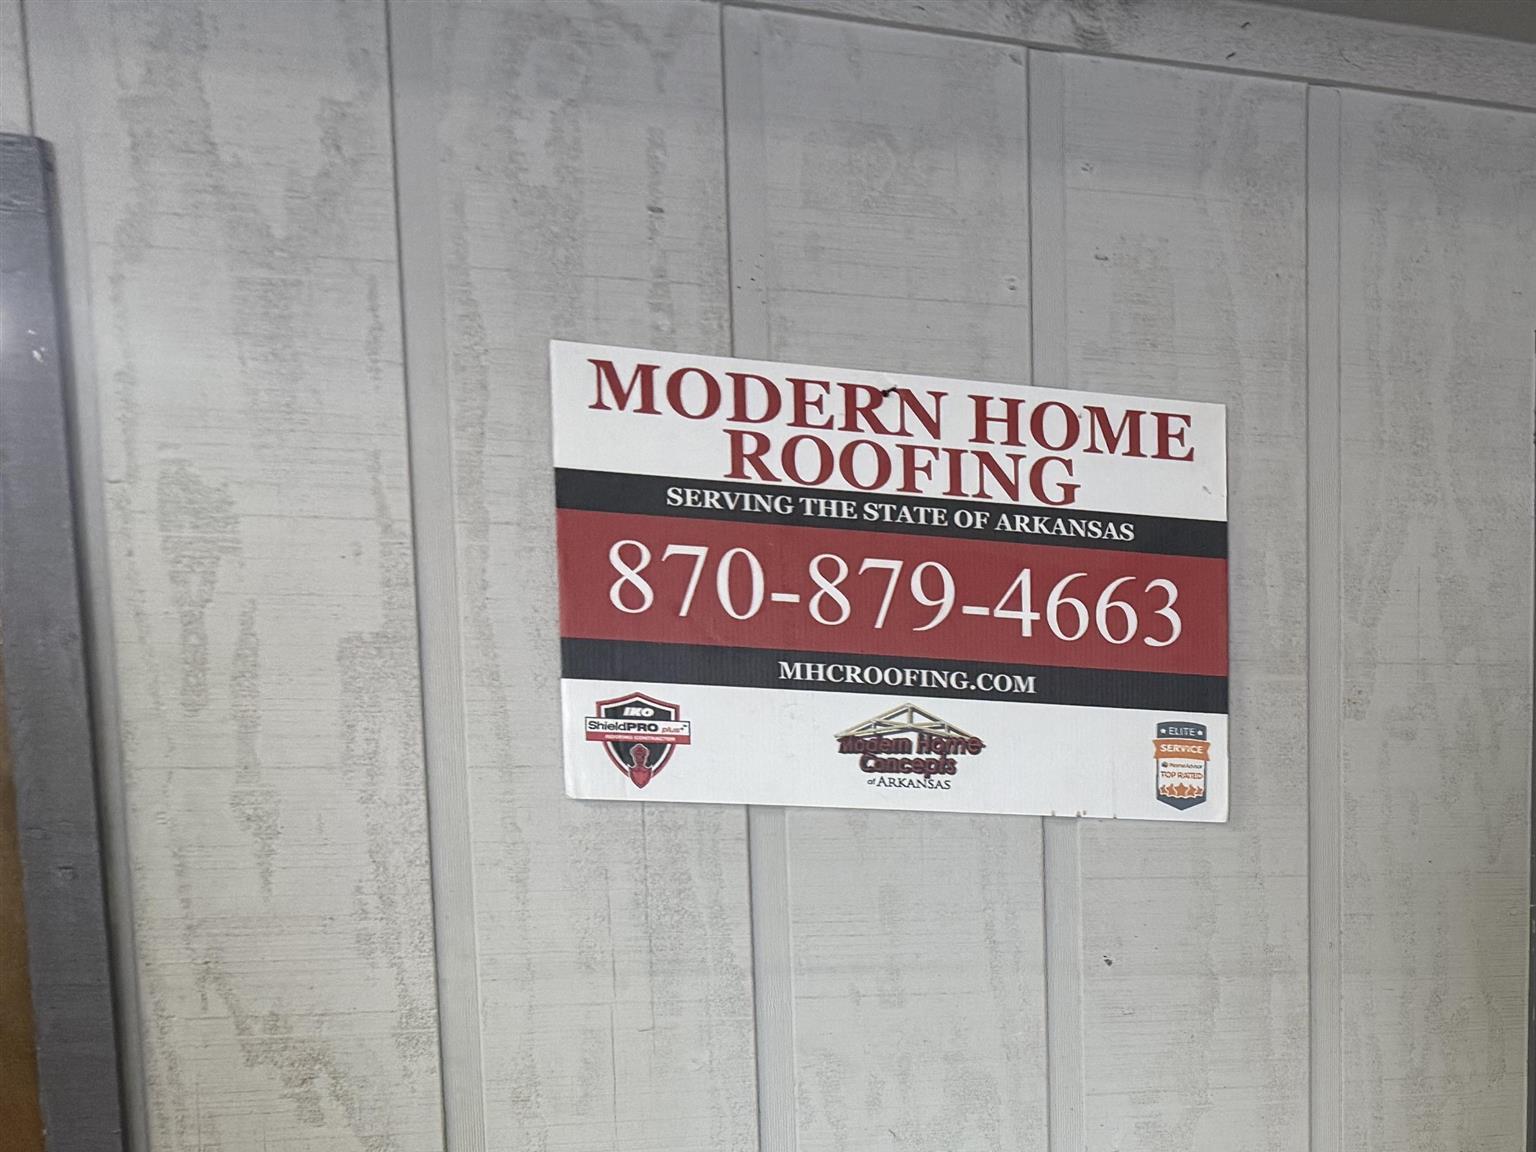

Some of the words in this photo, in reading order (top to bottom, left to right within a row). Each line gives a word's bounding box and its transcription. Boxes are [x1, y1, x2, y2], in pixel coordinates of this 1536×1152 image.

[587, 358, 948, 440] MODERN
[968, 394, 1196, 462] HOME
[722, 428, 1082, 506] ROOFING
[666, 486, 794, 516] SERVING
[799, 497, 859, 521] THE
[862, 501, 949, 527] STATE
[953, 509, 991, 530] OF
[996, 512, 1135, 541] ARKANSAS
[608, 539, 1183, 648] 870-879-4663
[777, 661, 1037, 694] MHCROOFING.COM
[622, 707, 655, 717] IKO
[588, 720, 659, 732] ShieldPRO
[1168, 726, 1196, 737] ELITE
[836, 734, 914, 754] Modern
[916, 731, 986, 755] Home
[1159, 743, 1204, 754] SERVICE
[859, 752, 958, 779] Concepts
[1160, 770, 1177, 779] TOP
[1177, 771, 1204, 780] RATED
[876, 776, 951, 790] ARKANSAS
